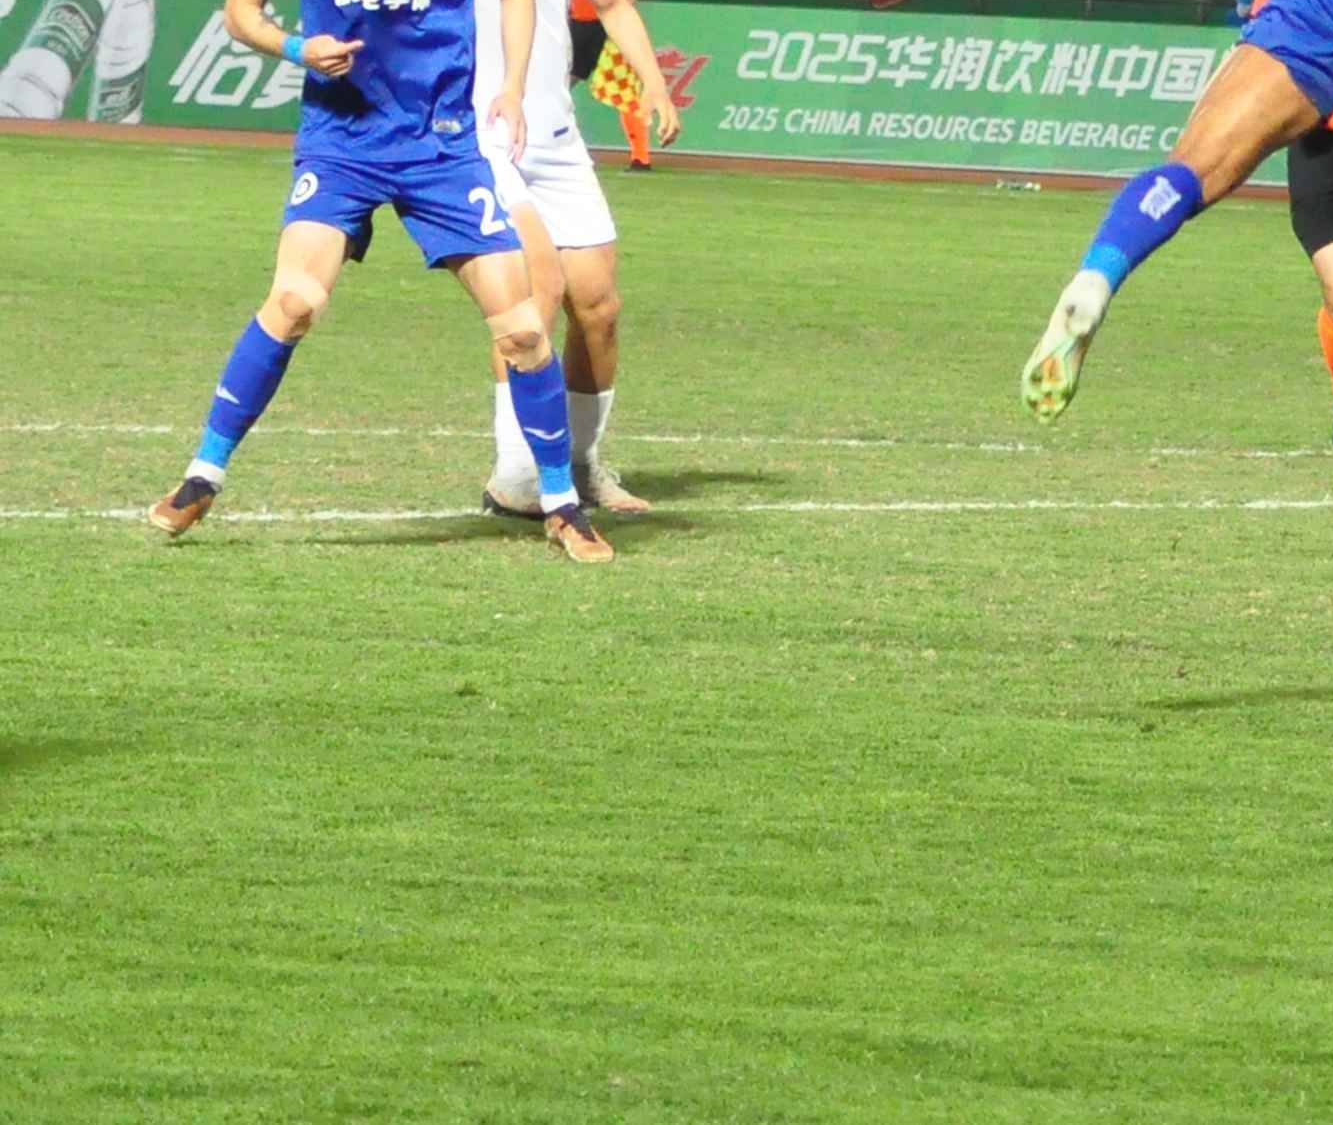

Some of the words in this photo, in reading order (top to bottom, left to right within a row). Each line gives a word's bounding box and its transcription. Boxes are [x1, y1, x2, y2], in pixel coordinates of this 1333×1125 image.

[168, 3, 304, 109] 怡
[718, 104, 779, 134] 2025
[783, 108, 861, 137] CHINA
[867, 113, 1013, 144] RESOURCES
[1019, 118, 1155, 151] BEVERAGE
